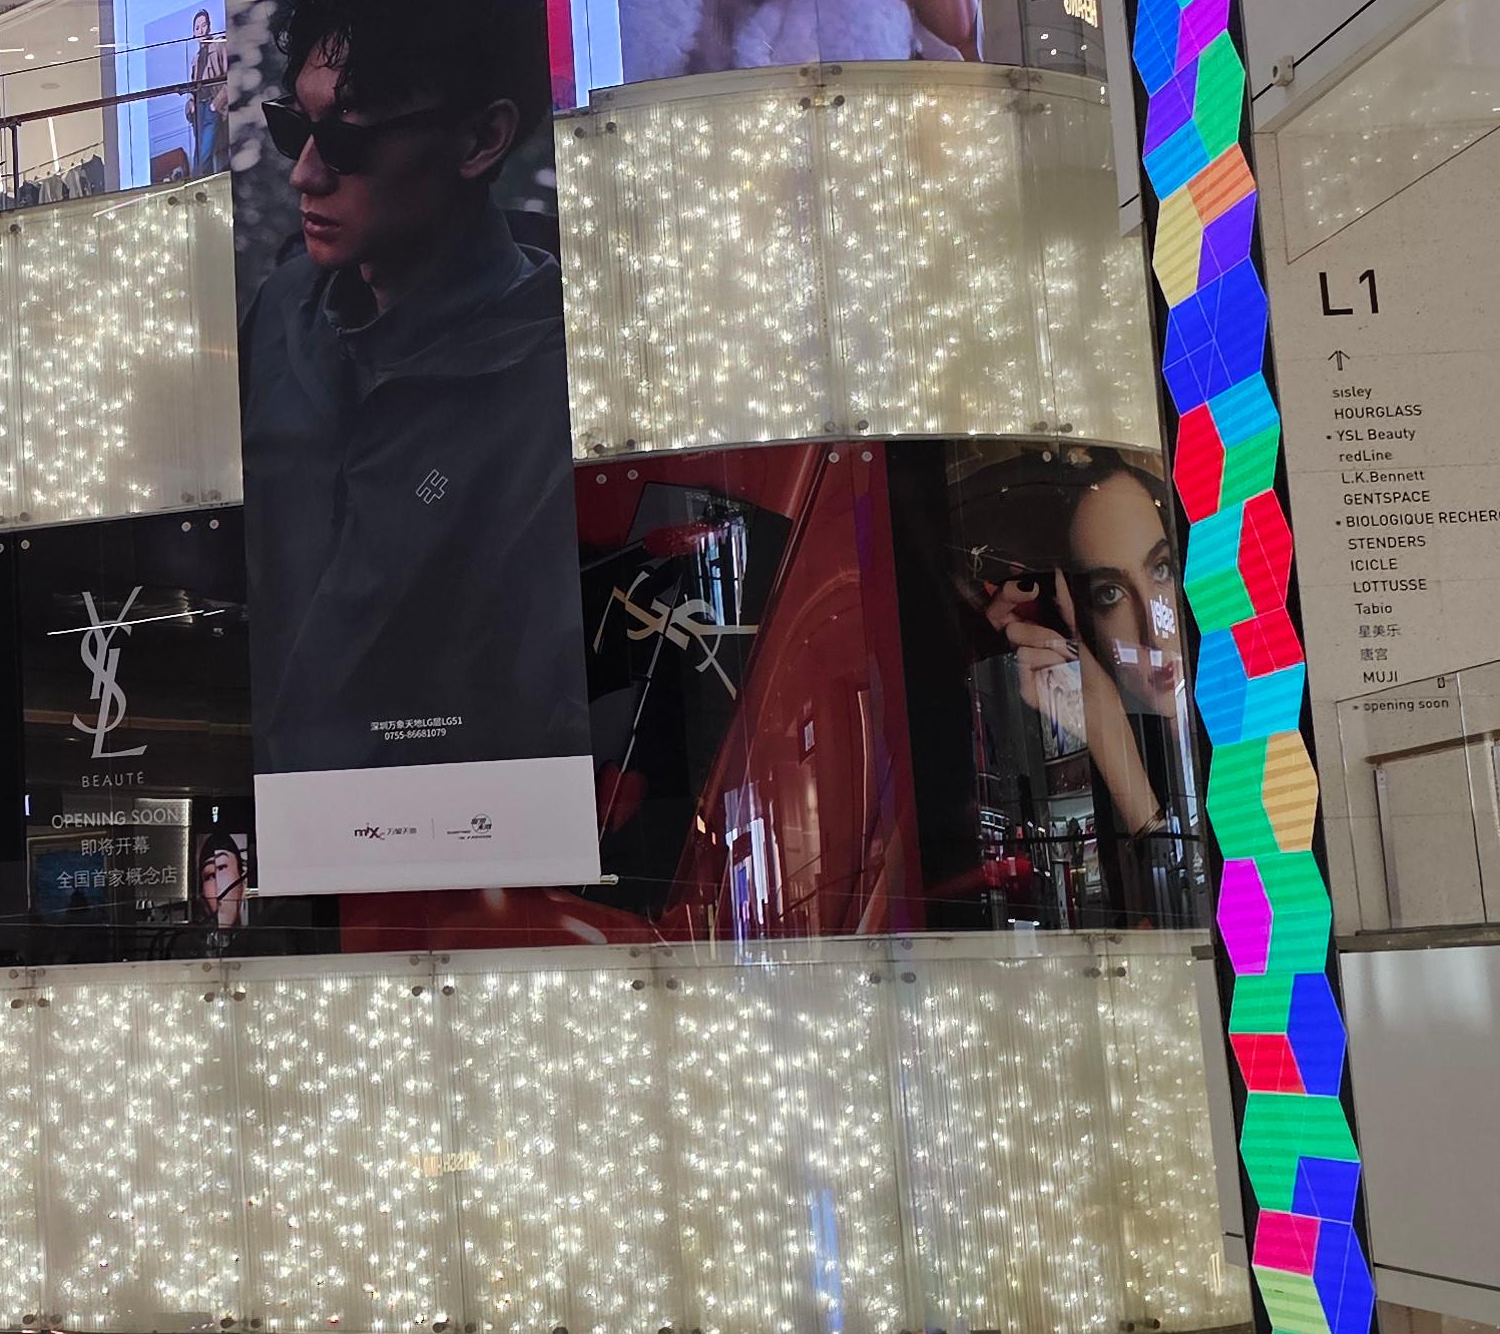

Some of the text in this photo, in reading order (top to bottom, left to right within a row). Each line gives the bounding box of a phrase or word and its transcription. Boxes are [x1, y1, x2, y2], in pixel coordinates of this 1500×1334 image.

[1319, 269, 1379, 316] L1
[1332, 386, 1372, 400] sisley
[1334, 405, 1422, 420] HOURGLASS
[1336, 428, 1416, 442] YSL Beauty
[1339, 450, 1393, 462] redLine
[1341, 470, 1425, 484] L.K.Bennett
[1343, 490, 1431, 505] GENTSPACE
[1346, 512, 1434, 528] BIOLOGIQUE
[1348, 535, 1426, 550] STENDERS
[1350, 558, 1398, 572] ICICLE
[1353, 579, 1427, 593] LOTTUSSE
[1355, 603, 1393, 615] Tabio
[1358, 624, 1401, 638] 星美乐
[72, 586, 148, 759] YSL
[1363, 670, 1398, 684] MUJI
[1363, 697, 1449, 712] opening soon
[81, 771, 145, 788] BEAUTÉ
[52, 808, 180, 829] OPENING SOON
[81, 835, 150, 857] 即将开幕
[56, 865, 178, 890] 全国首家概念店
